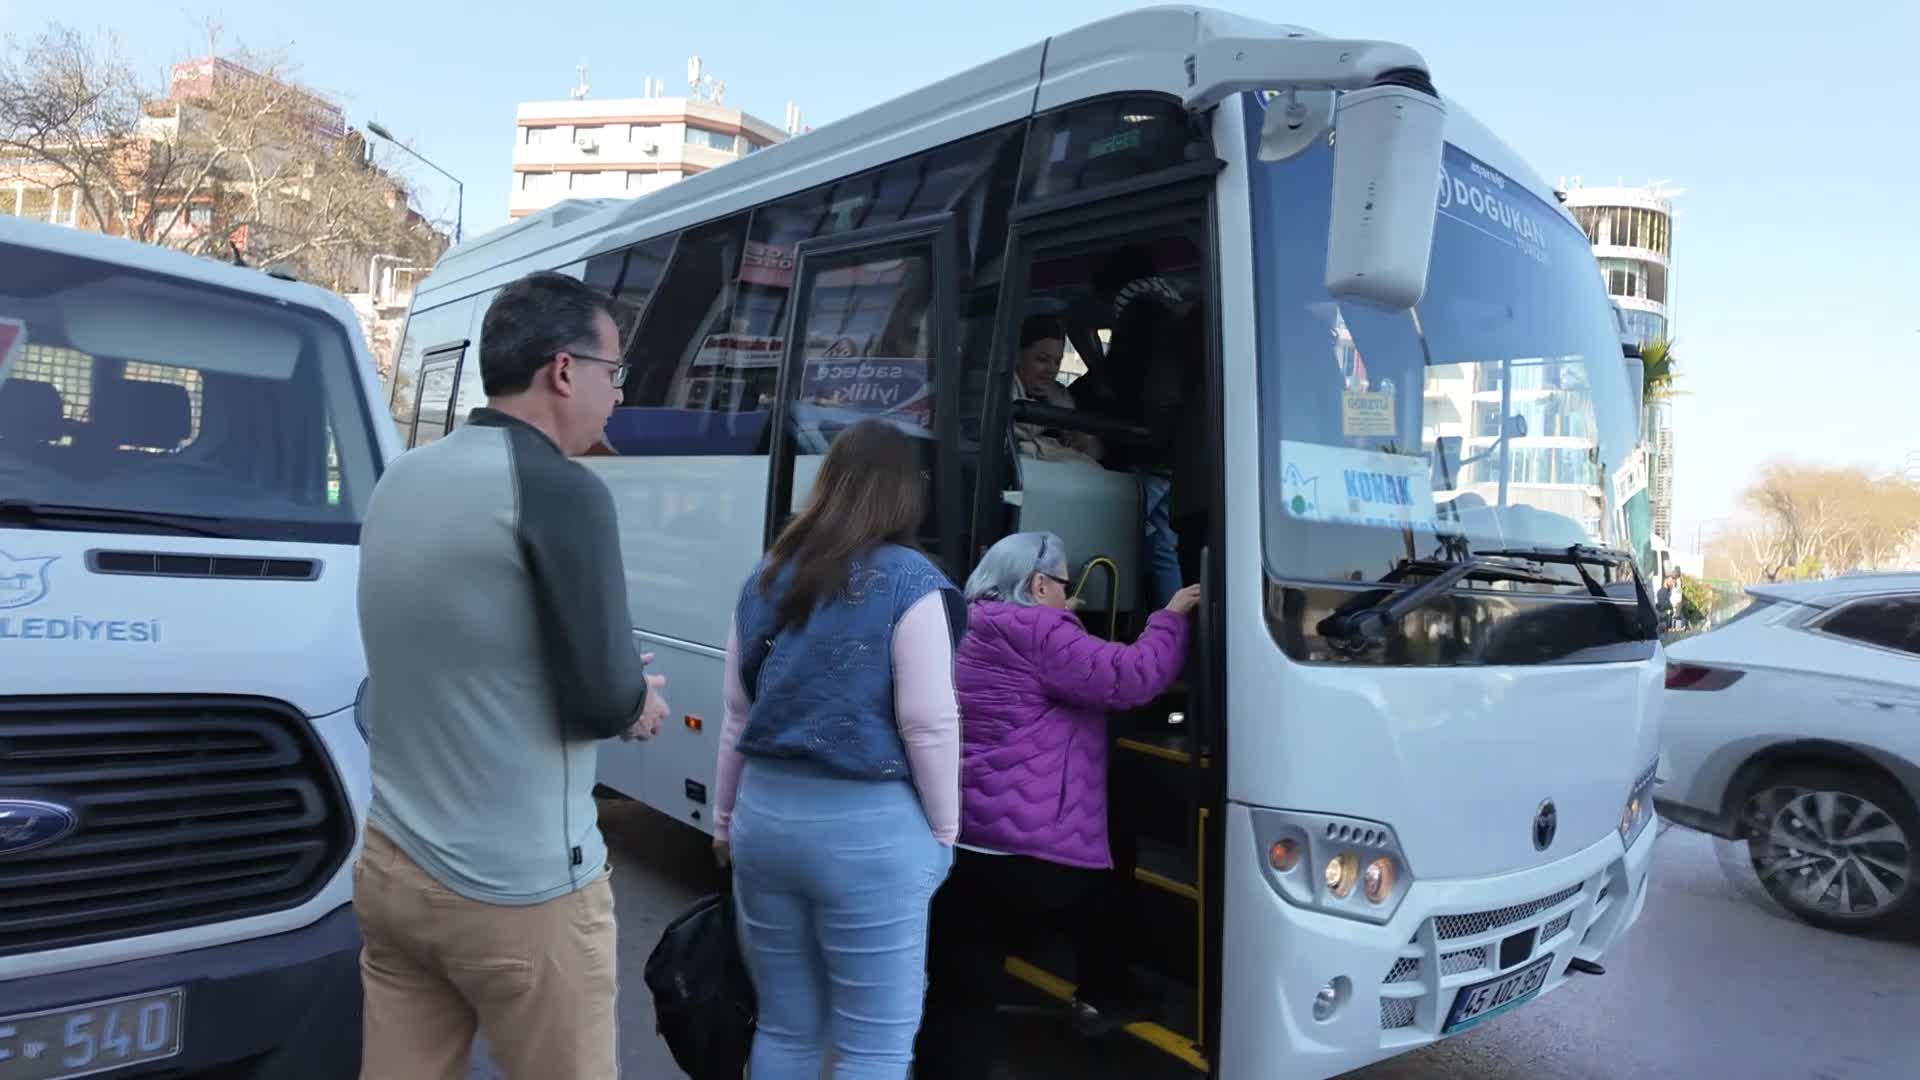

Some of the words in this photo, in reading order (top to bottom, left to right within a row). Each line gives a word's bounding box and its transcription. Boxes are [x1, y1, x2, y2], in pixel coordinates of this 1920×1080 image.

[1453, 176, 1546, 248] DOĞUKAN
[1343, 468, 1415, 506] KONAK
[0, 615, 161, 643] LEDİYESİ
[1464, 987, 1489, 1017] 45
[63, 1000, 171, 1069] 540
